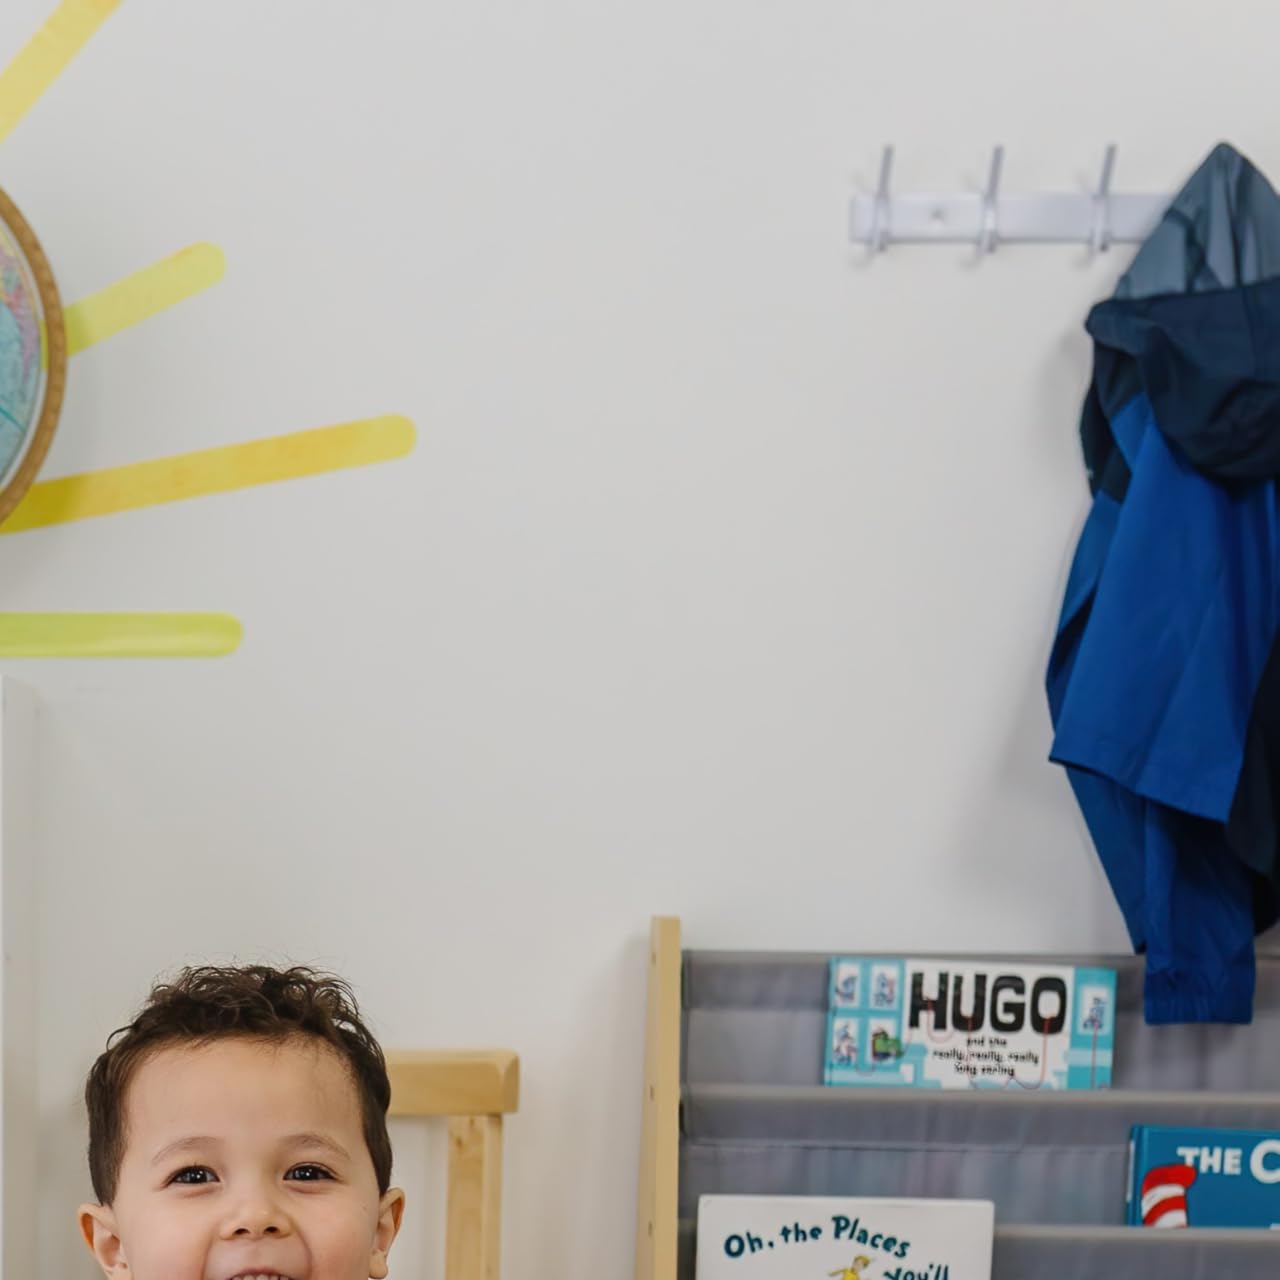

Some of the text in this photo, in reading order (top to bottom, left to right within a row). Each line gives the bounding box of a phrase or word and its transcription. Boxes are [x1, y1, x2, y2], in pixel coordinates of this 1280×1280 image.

[909, 971, 1067, 1034] HUGO
[1176, 1147, 1242, 1175] THE
[780, 1222, 823, 1243] the
[831, 1215, 911, 1258] Places
